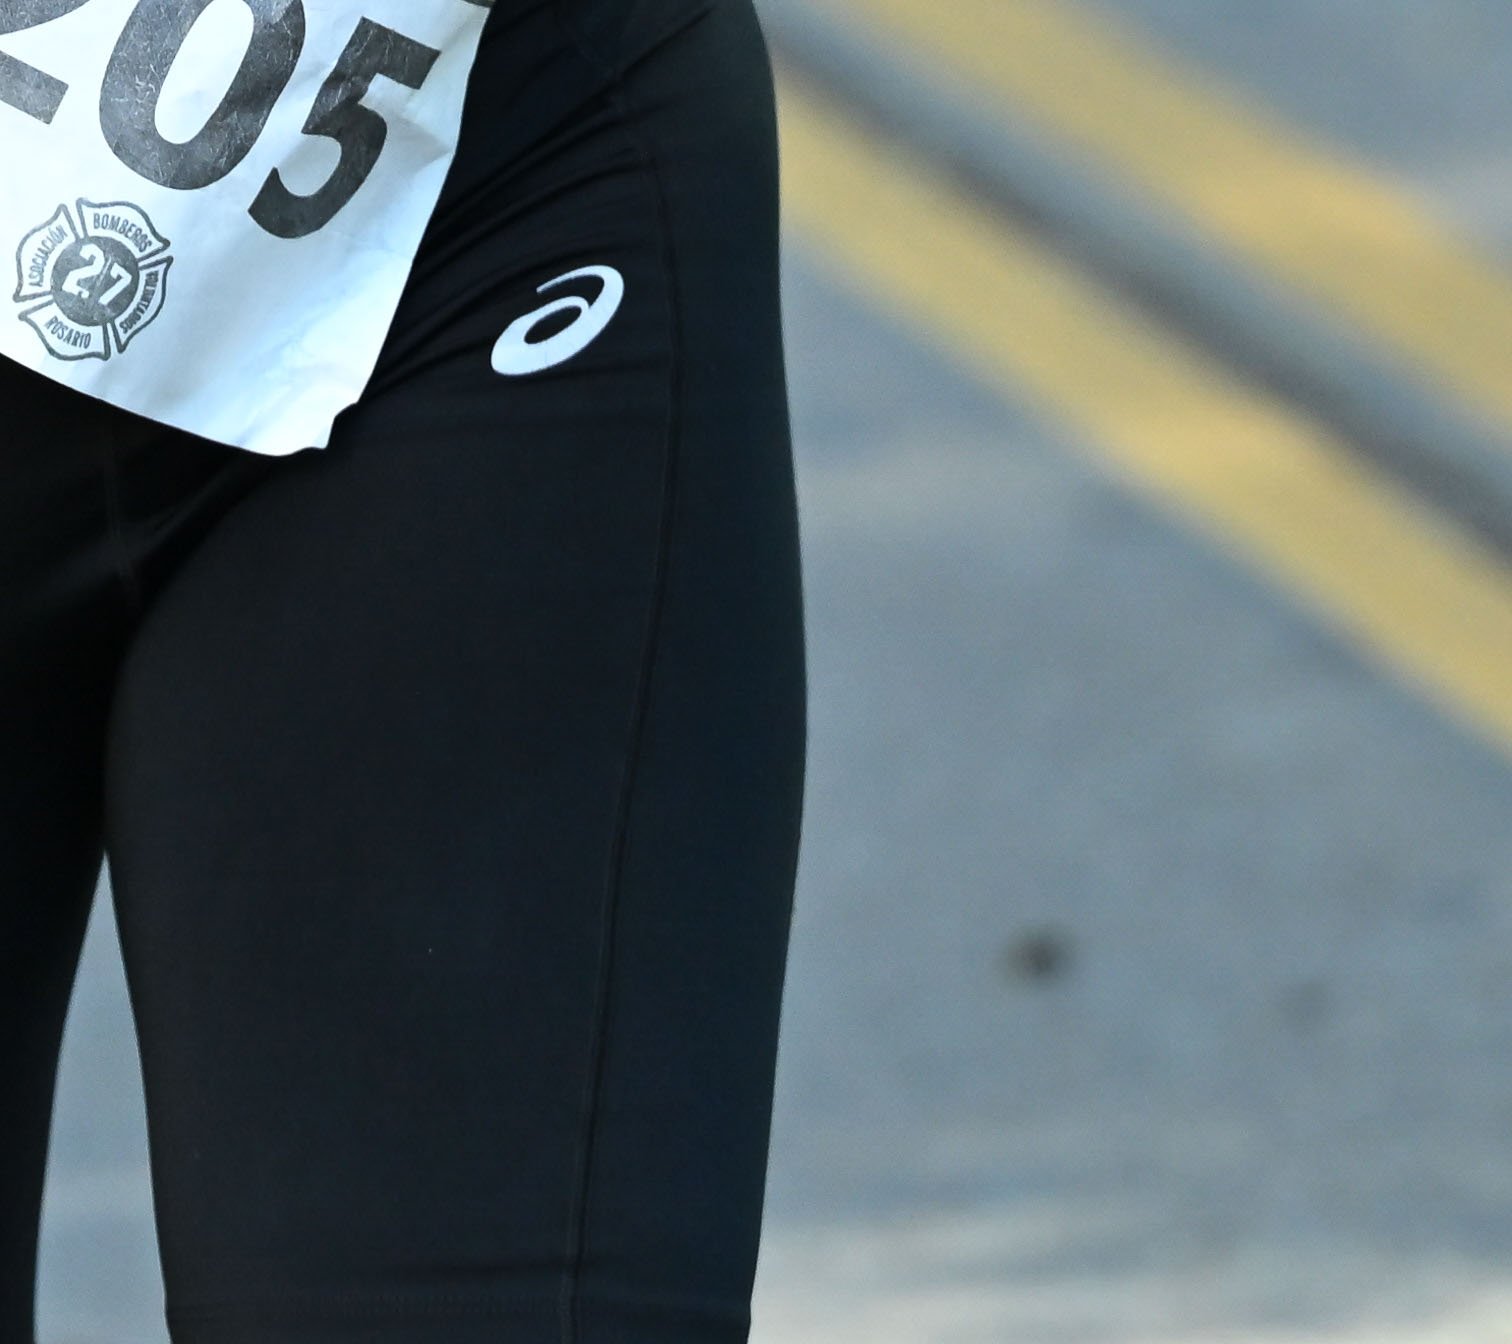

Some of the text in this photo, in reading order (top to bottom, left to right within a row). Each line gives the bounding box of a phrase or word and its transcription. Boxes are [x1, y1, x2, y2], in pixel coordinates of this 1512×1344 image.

[93, 212, 152, 253] BOMBEROS
[61, 242, 133, 307] 27
[43, 315, 92, 350] ROSARIO
